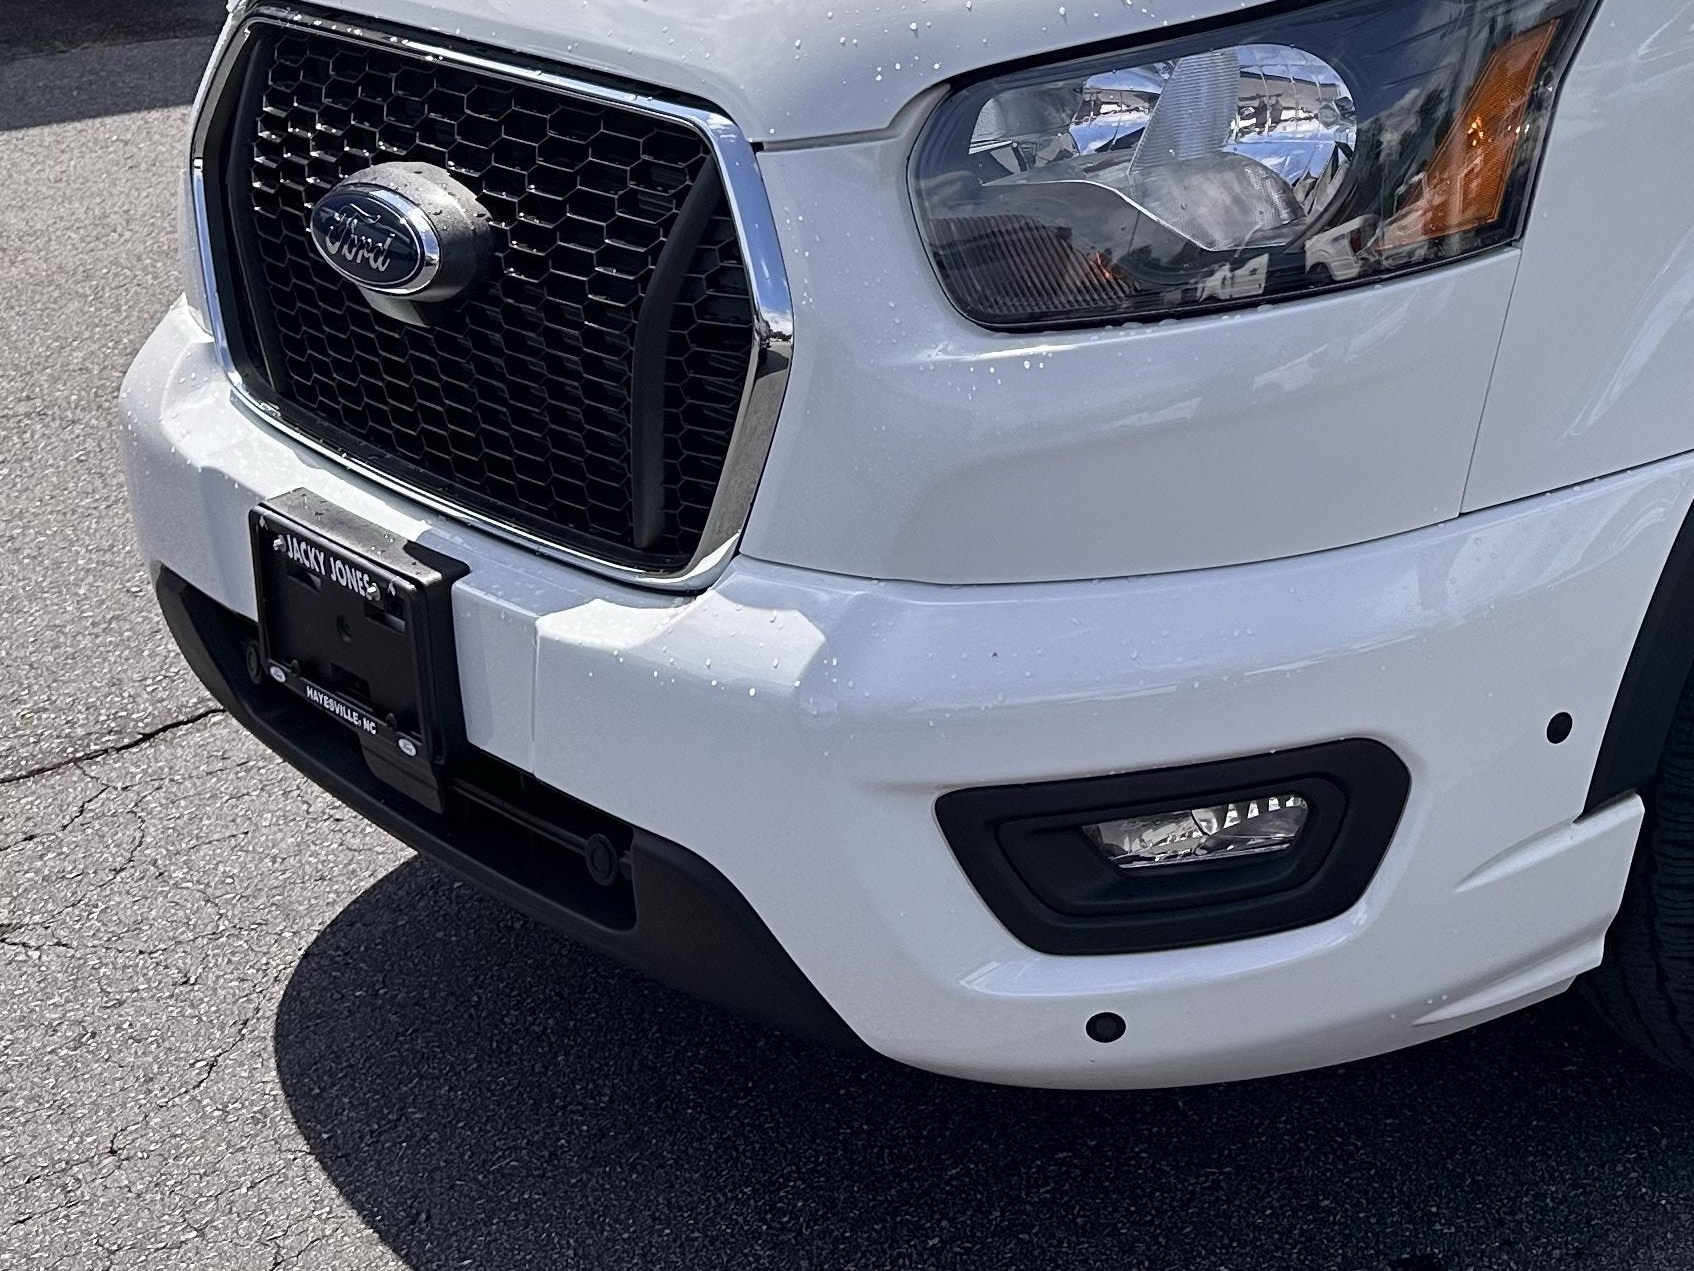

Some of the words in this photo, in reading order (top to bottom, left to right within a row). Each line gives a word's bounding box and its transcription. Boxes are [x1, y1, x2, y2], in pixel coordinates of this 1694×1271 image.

[324, 203, 396, 272] Ford
[286, 534, 326, 575] JACKY
[306, 685, 362, 727] HAYESVILLE,
[362, 716, 377, 735] NC
